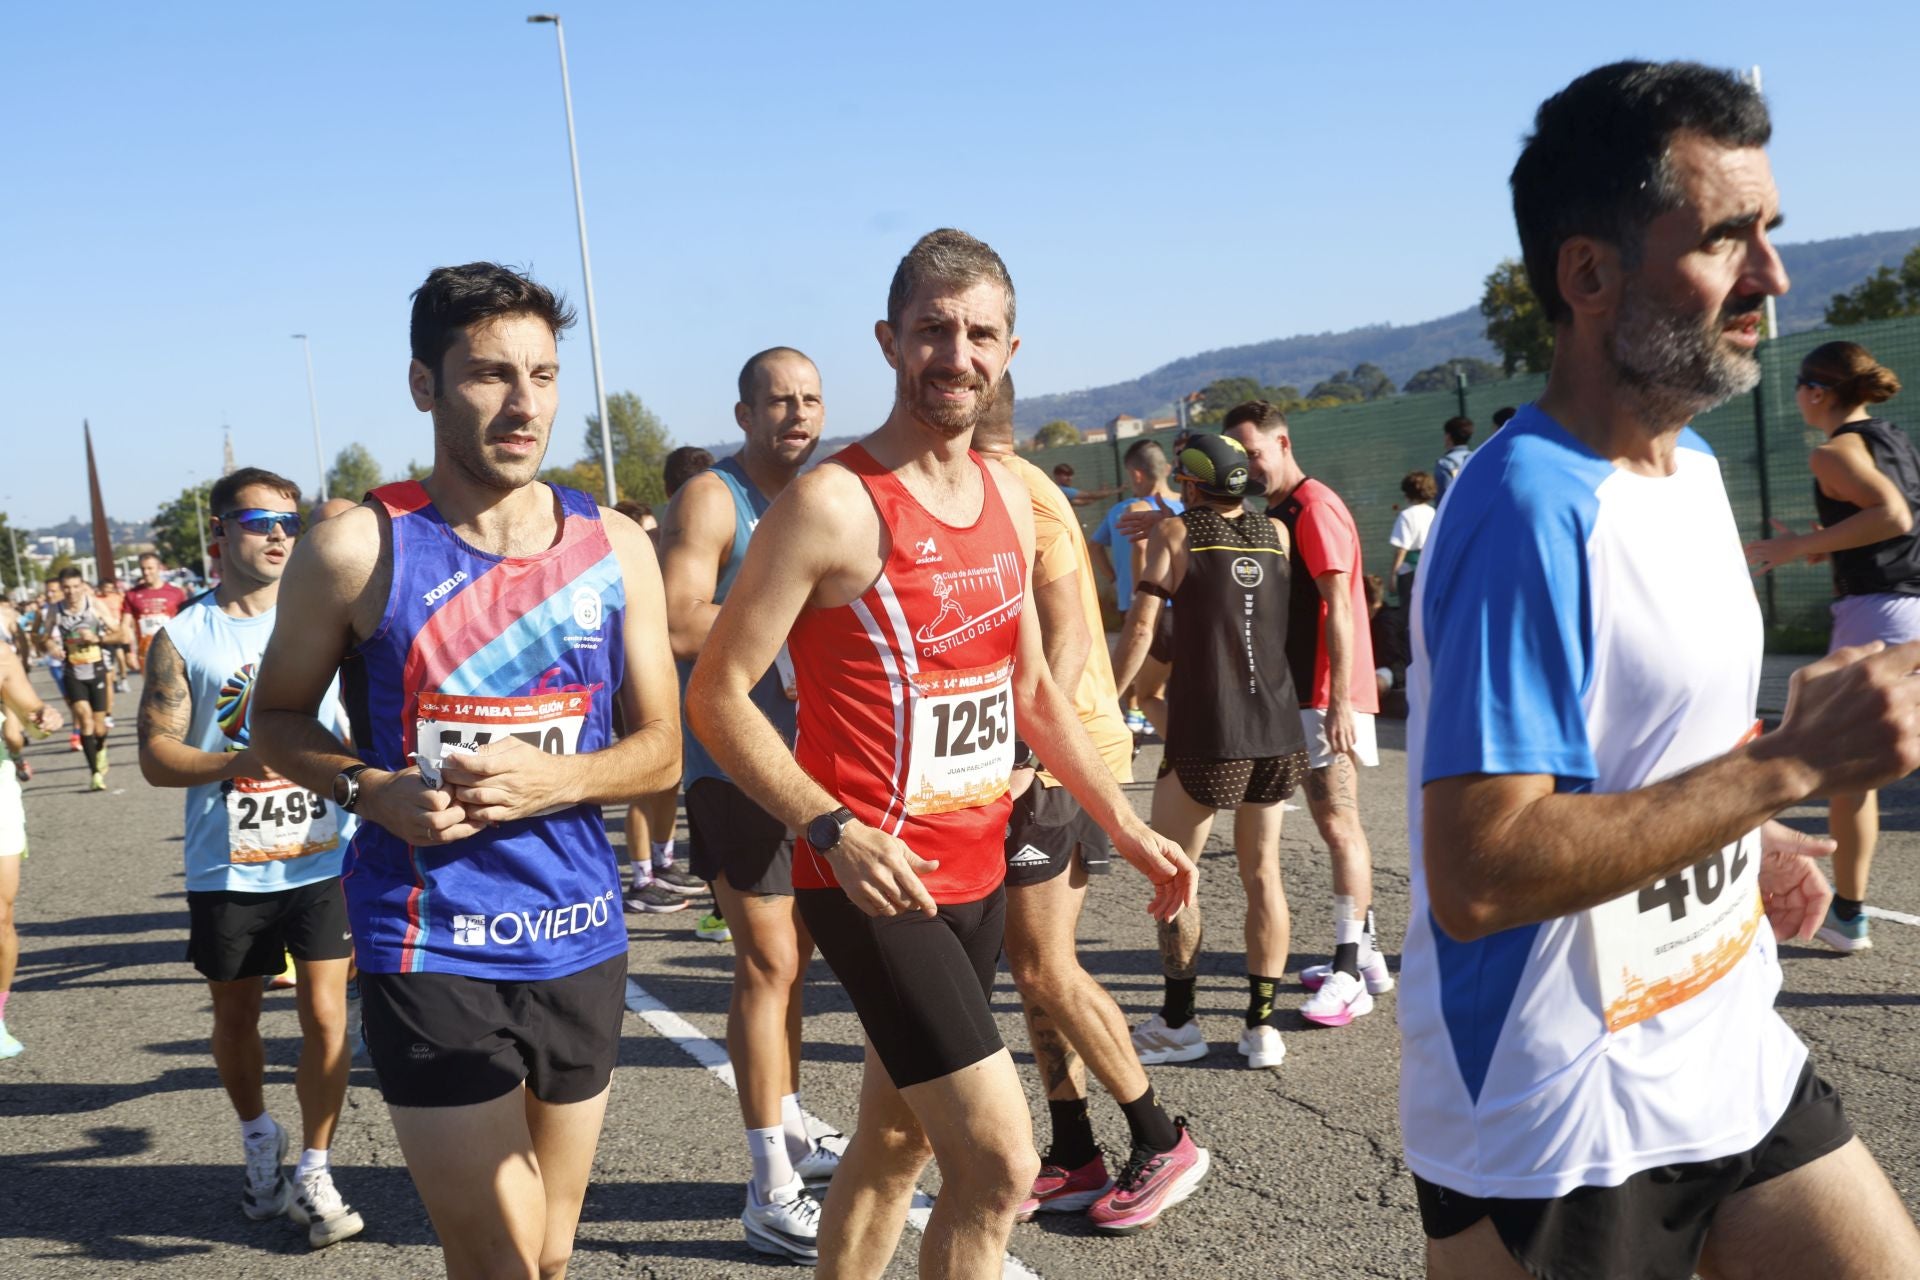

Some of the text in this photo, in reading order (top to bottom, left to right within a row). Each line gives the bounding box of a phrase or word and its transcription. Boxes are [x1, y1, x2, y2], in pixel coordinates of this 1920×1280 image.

[943, 572, 958, 580] Club
[968, 566, 997, 577] Atletismo
[923, 627, 976, 658] CASTILLO
[978, 620, 992, 635] DE
[993, 613, 1007, 628] LA
[959, 675, 983, 687] MBA
[474, 705, 512, 717] MBA
[932, 689, 1008, 757] 1253
[237, 791, 328, 830] 2499
